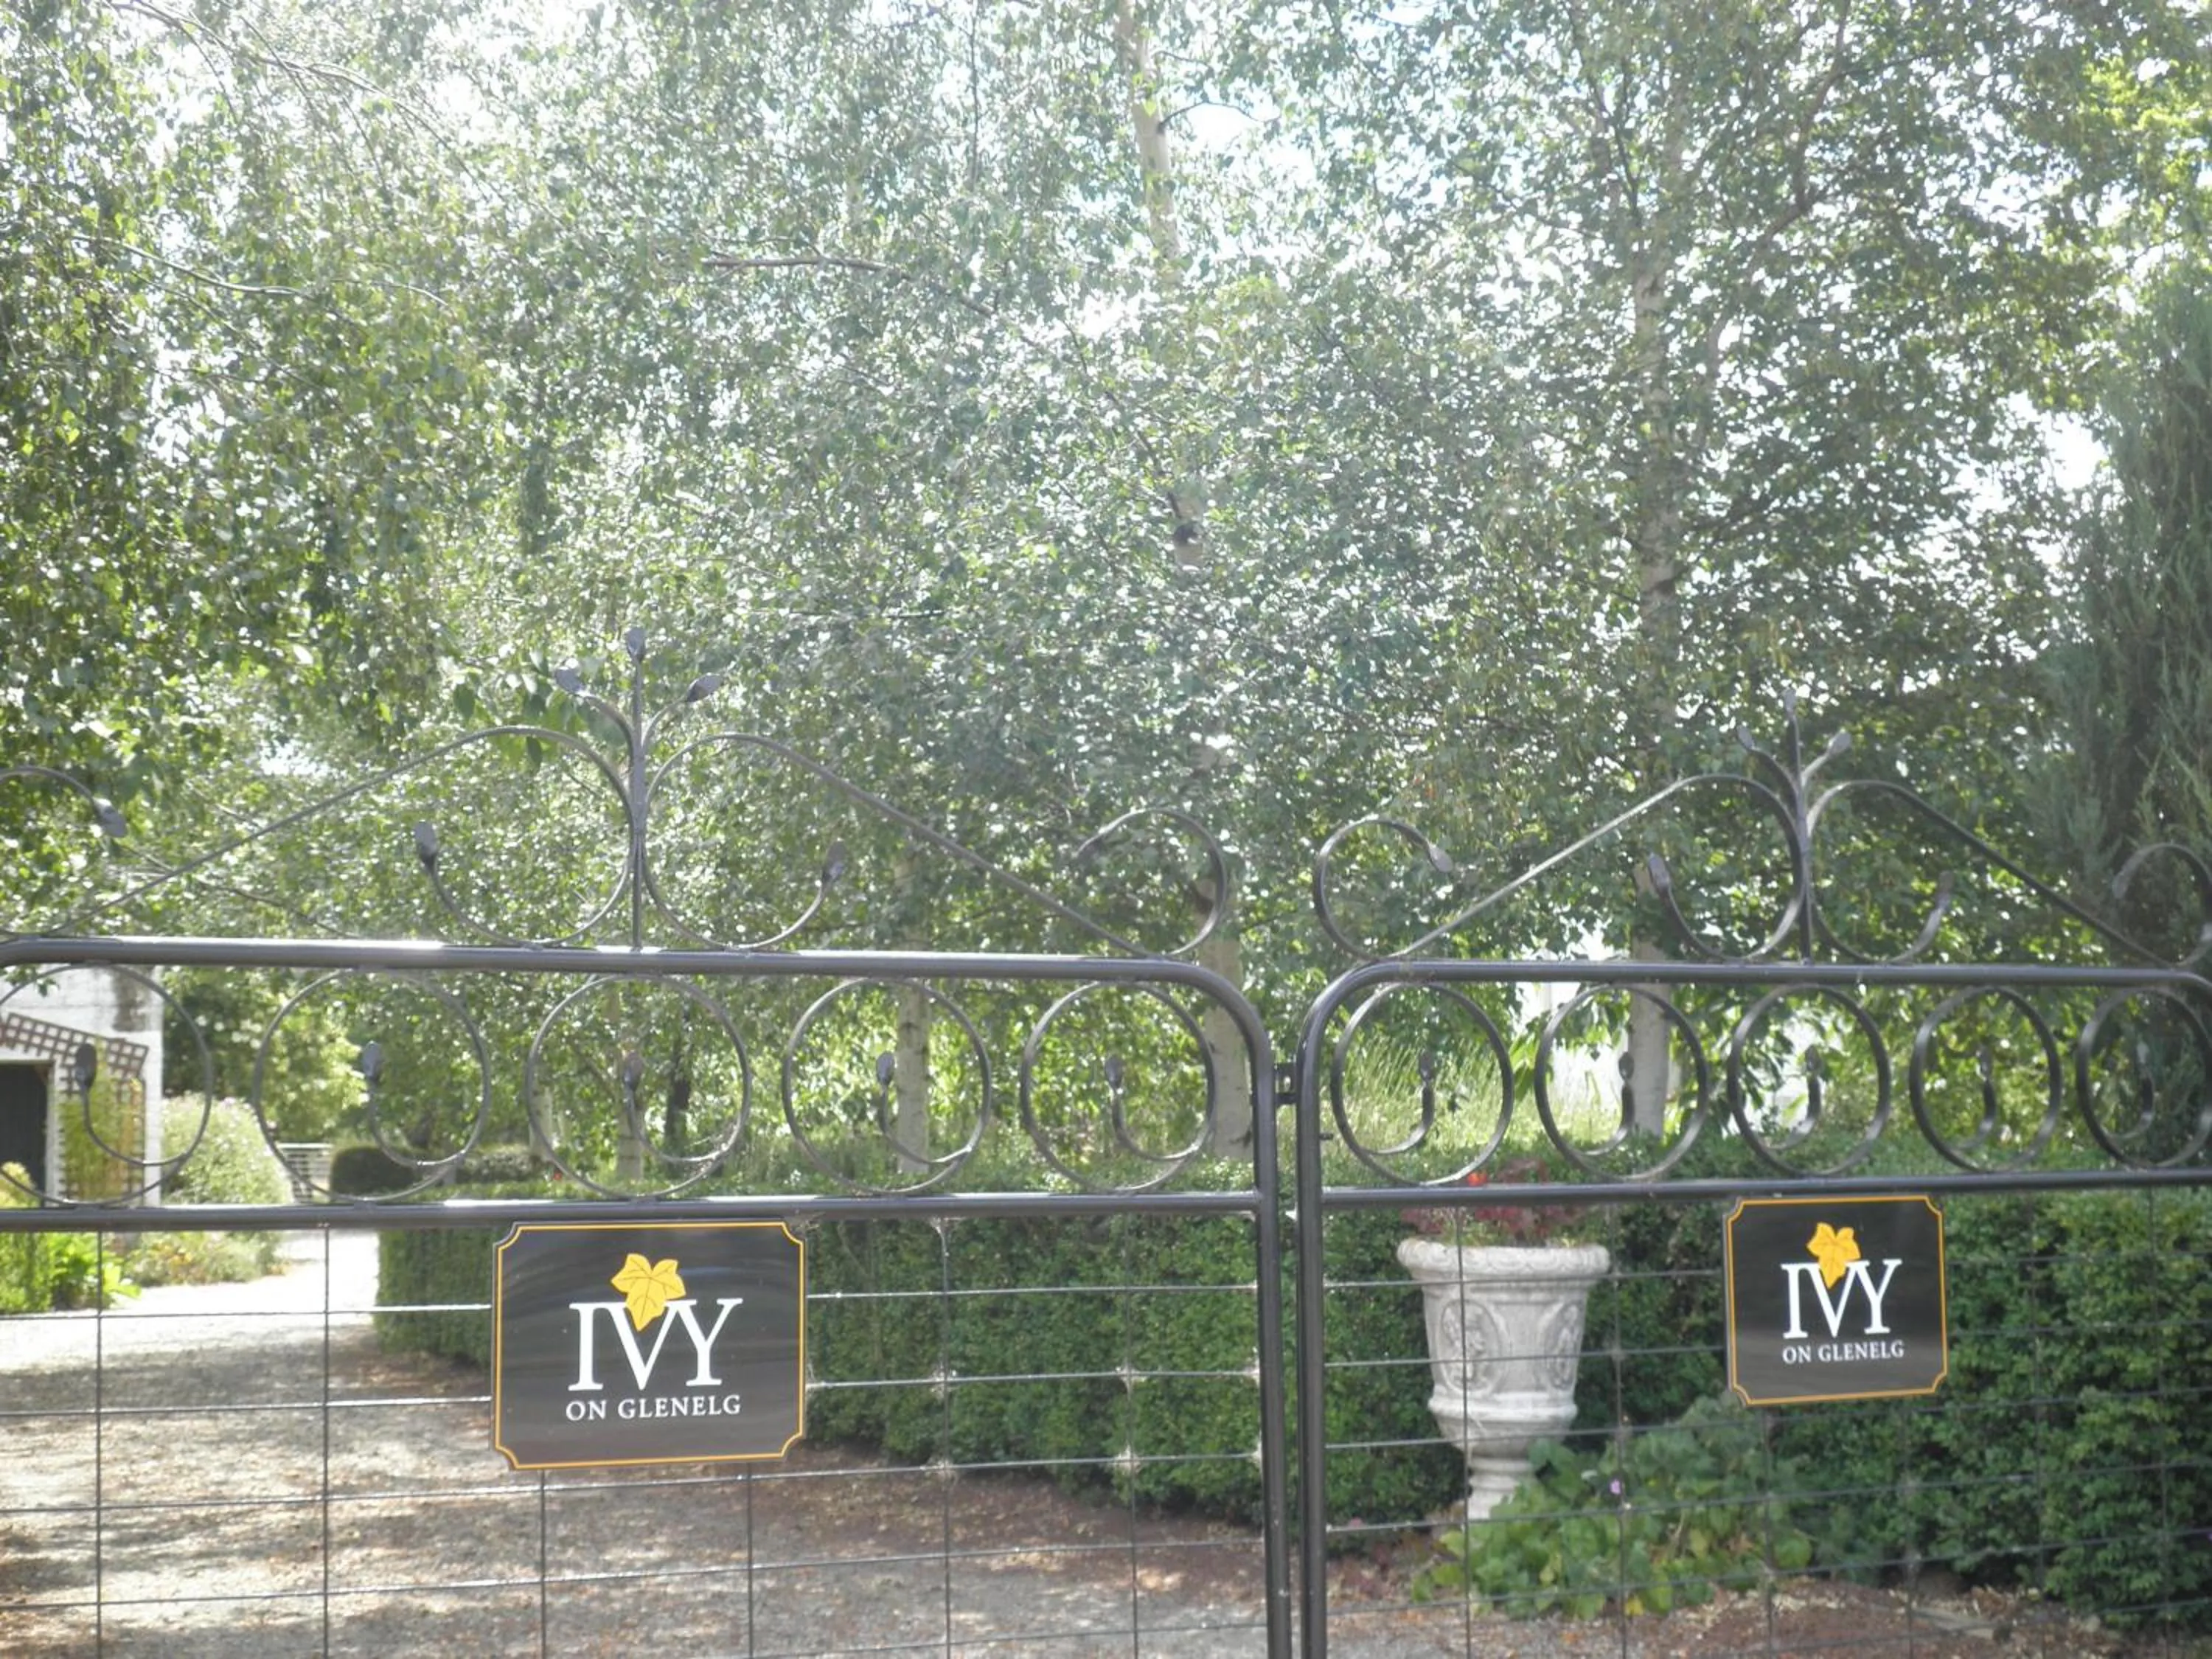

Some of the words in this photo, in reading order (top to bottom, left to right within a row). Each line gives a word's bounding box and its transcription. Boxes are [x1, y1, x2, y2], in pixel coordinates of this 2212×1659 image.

[1780, 1259, 1902, 1339] IVY
[568, 1298, 743, 1391] IVY
[1782, 1346, 1812, 1363] ON
[1818, 1340, 1905, 1362] GLENELG
[566, 1400, 607, 1421] ON
[617, 1395, 742, 1419] GLENELG
